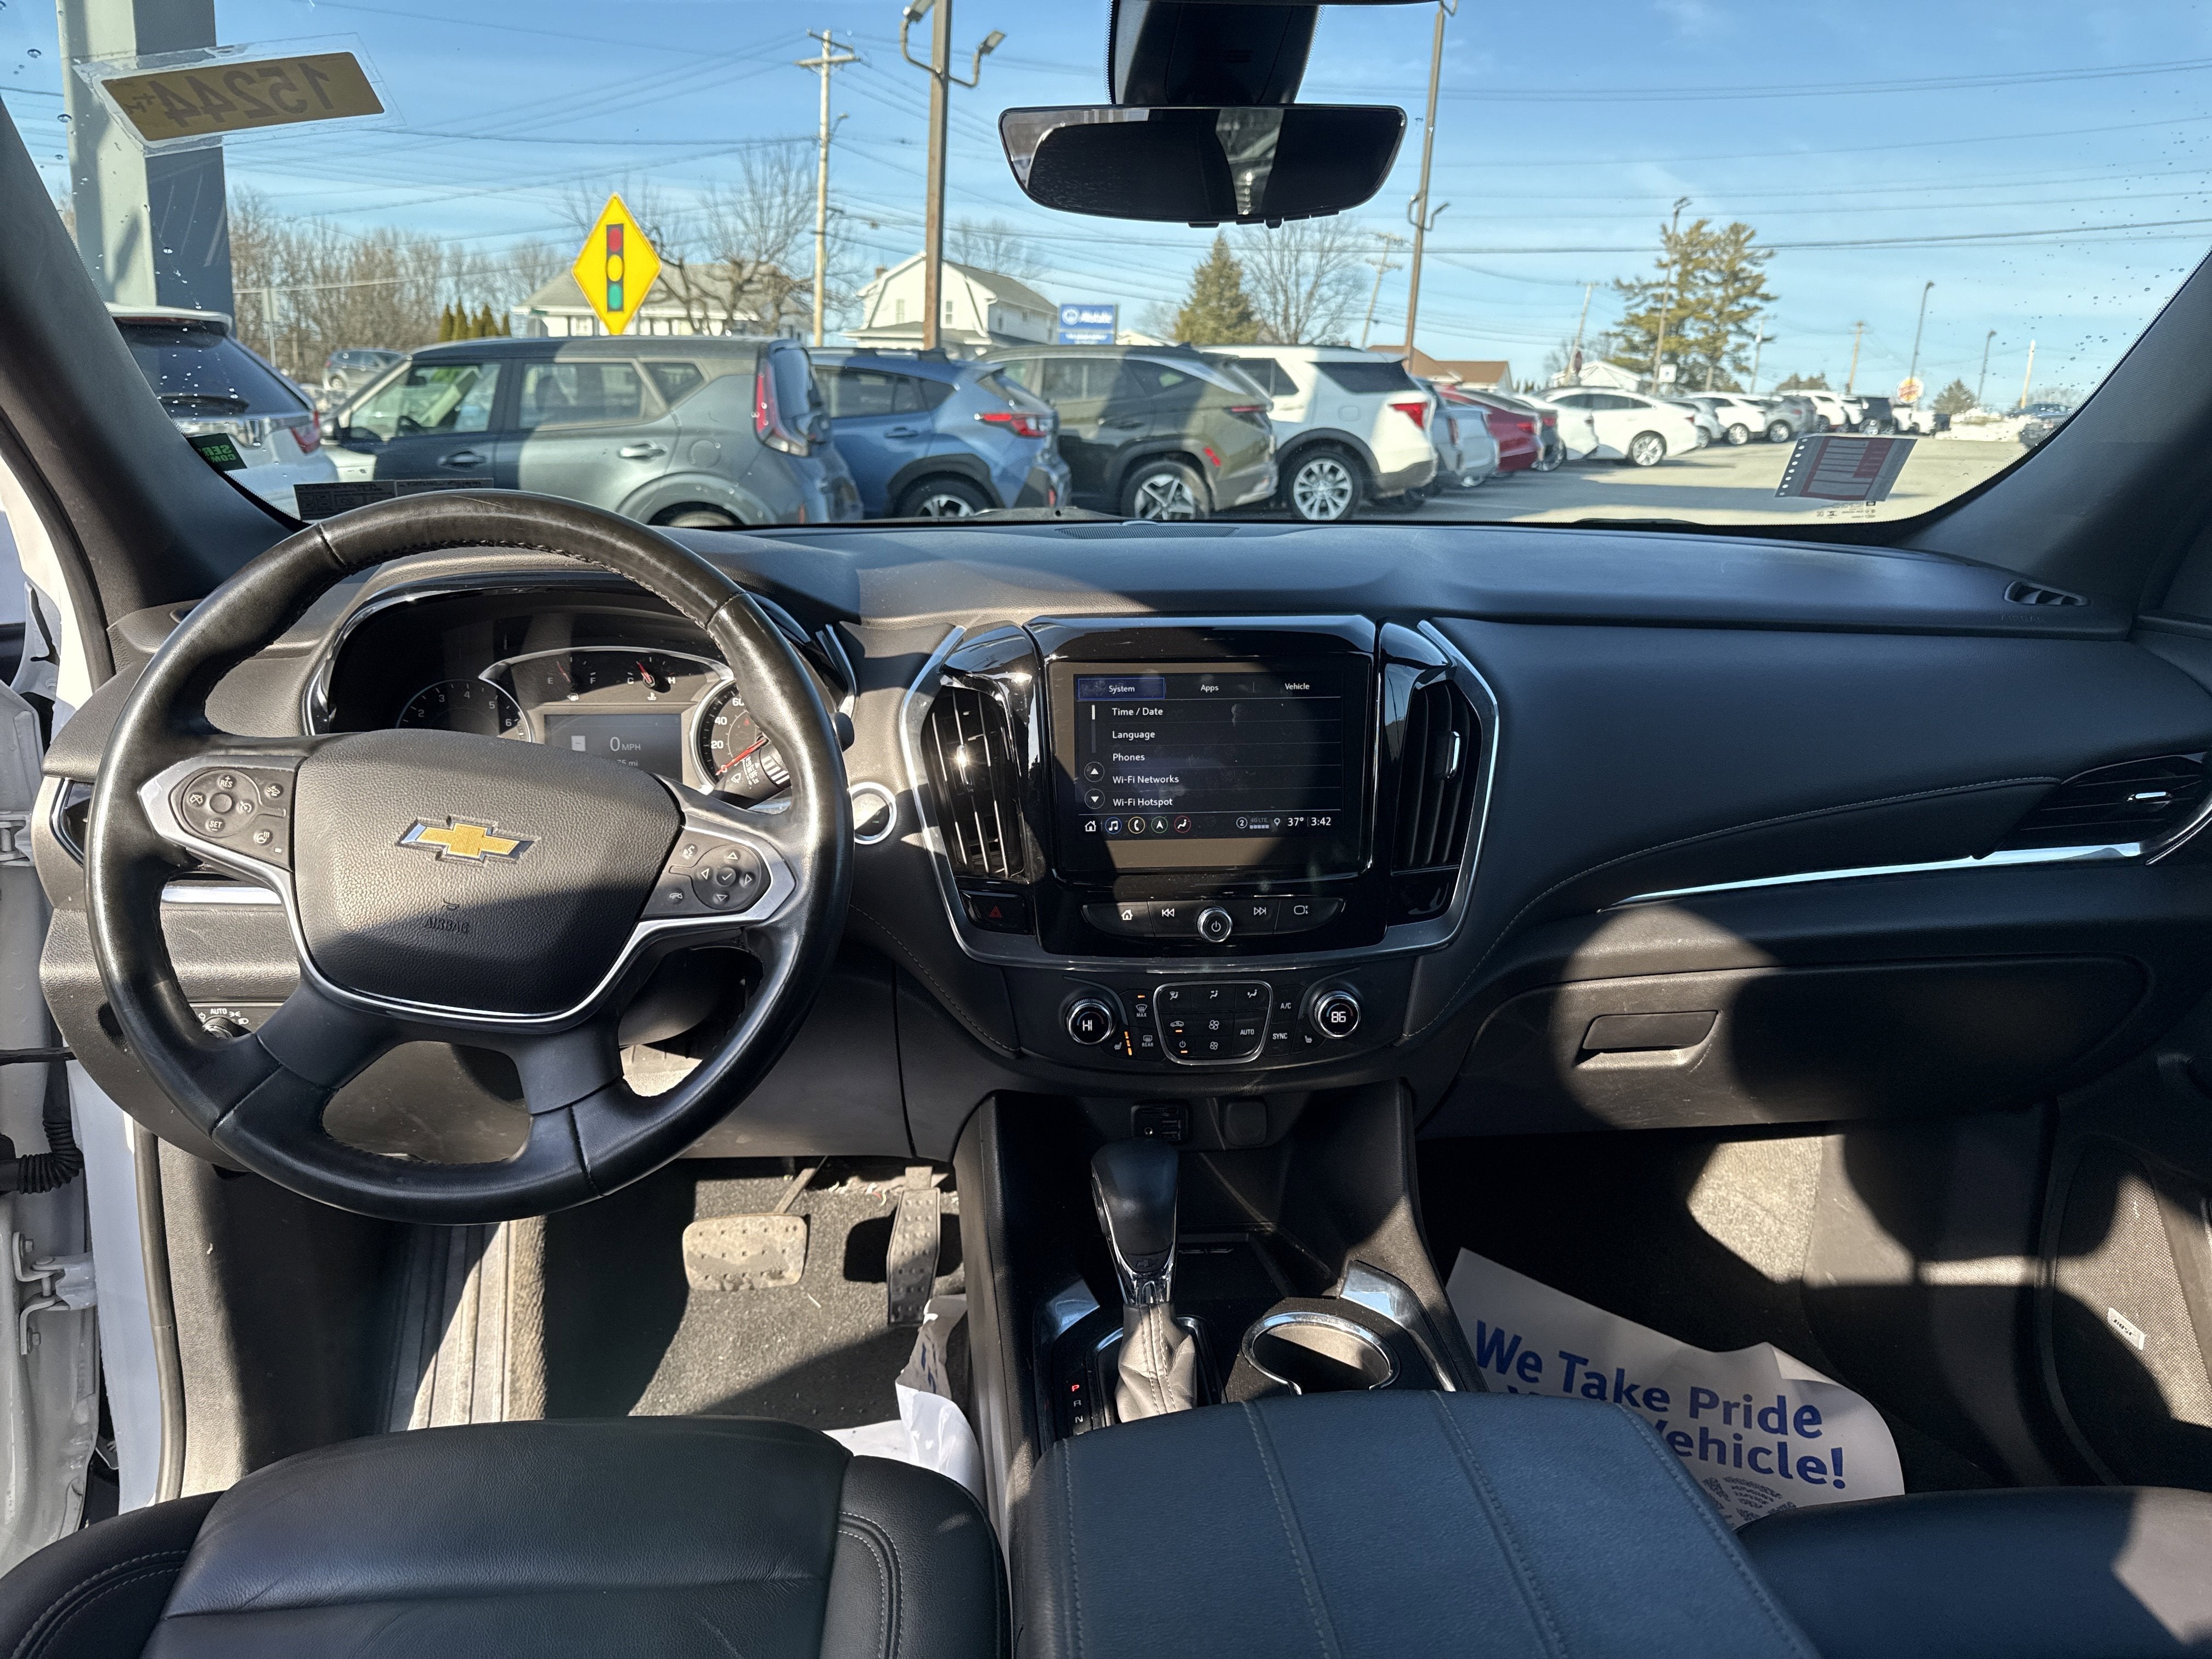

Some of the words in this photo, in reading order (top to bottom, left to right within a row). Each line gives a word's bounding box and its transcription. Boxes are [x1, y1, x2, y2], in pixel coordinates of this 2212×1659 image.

[1109, 685, 1135, 695] System
[1200, 684, 1218, 693] Apps
[1112, 708, 1134, 716] Time
[1142, 708, 1163, 716] Date
[1112, 730, 1155, 740] Language
[610, 737, 620, 752] 0
[1113, 753, 1145, 761] Phones
[220, 780, 233, 788] RES
[1113, 775, 1135, 784] Wi-Fi
[1137, 775, 1180, 783] Networks
[1113, 798, 1135, 807] Wi-Fi
[1137, 798, 1173, 808] Hotspot
[1287, 817, 1304, 826] 37°
[1311, 817, 1331, 826] 3:42
[422, 917, 469, 933] AIRBAG
[1331, 1011, 1346, 1023] 86
[1082, 1019, 1092, 1031] HI
[1476, 1319, 1543, 1383] We
[1558, 1351, 1670, 1413] Take
[1689, 1386, 1824, 1439] Pride
[1075, 1415, 1084, 1424] N
[1655, 1419, 1846, 1489] ehicle!
